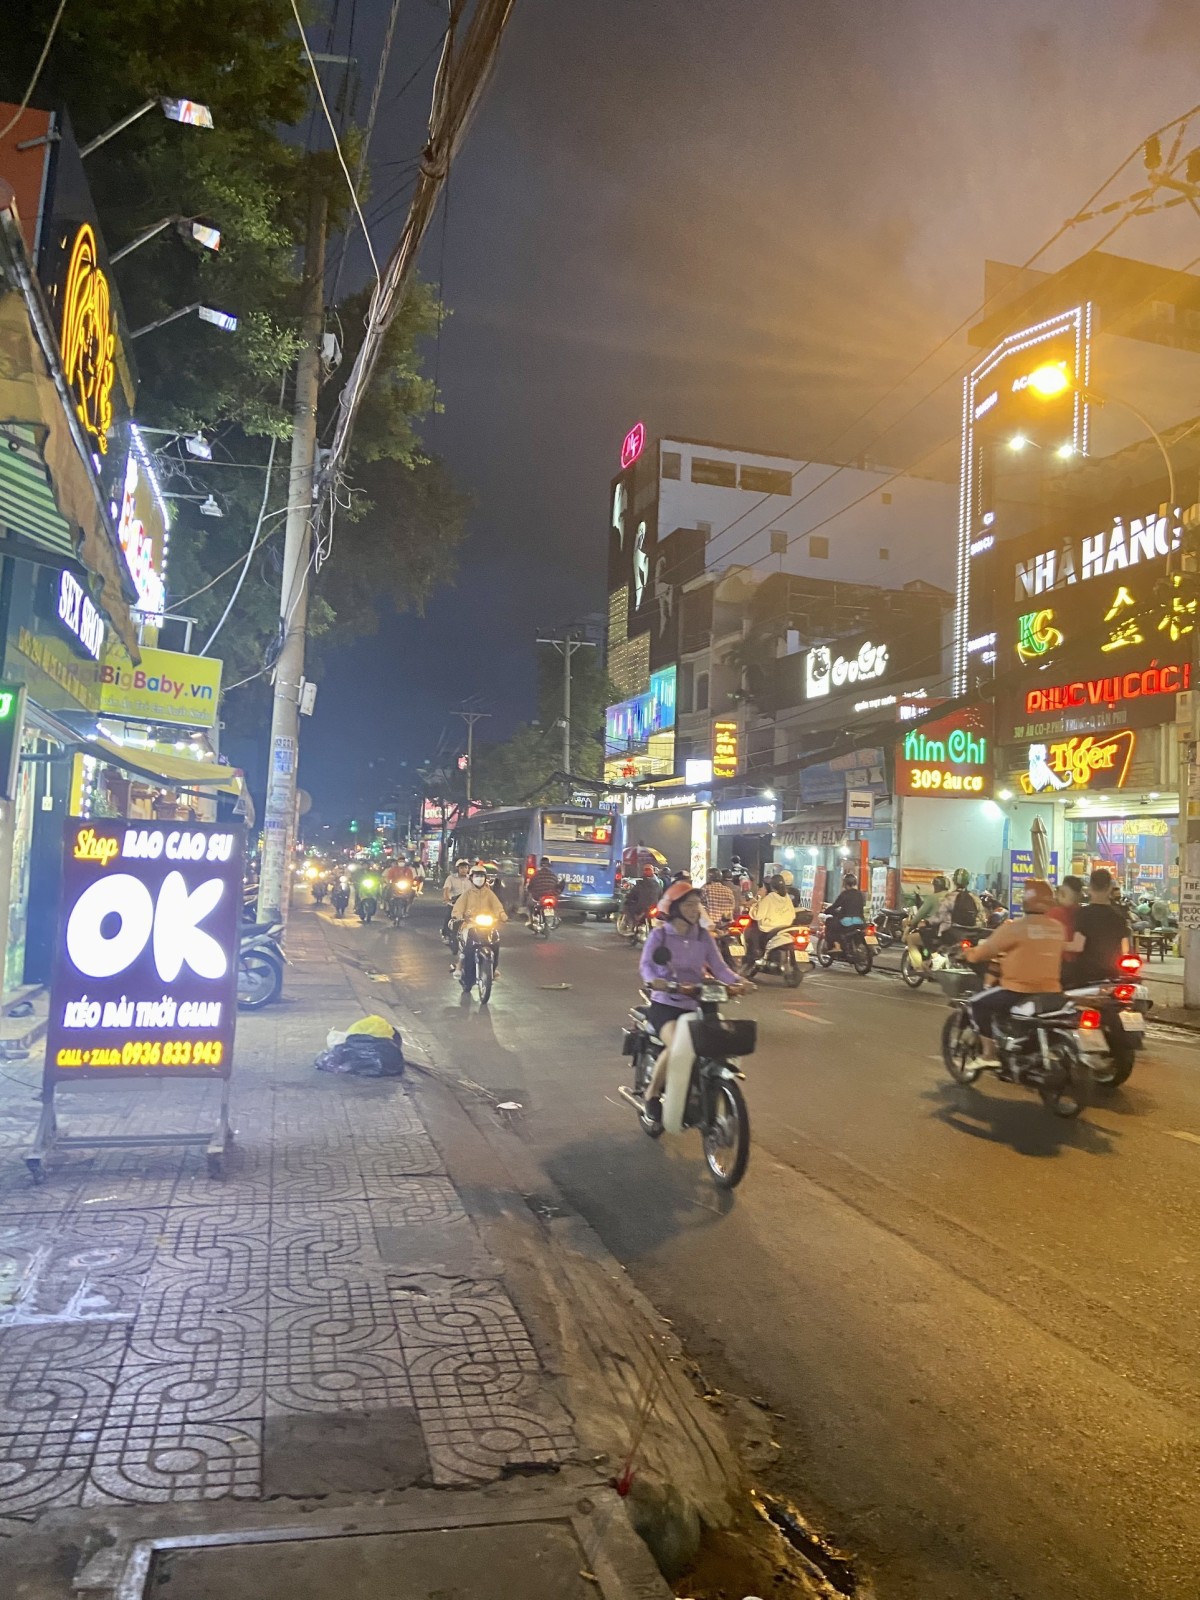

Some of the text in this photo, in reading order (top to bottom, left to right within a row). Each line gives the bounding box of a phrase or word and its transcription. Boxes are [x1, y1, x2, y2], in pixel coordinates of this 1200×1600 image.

[1014, 536, 1077, 602] NHÀ
[58, 570, 105, 661] SEX SHOP
[101, 665, 213, 699] BigBaby.vn
[1087, 676, 1122, 709] VỤ
[1123, 659, 1180, 699] CÁC
[948, 729, 987, 764] Chi
[1049, 736, 1119, 783] Tiger
[910, 769, 942, 788] 309
[942, 771, 962, 790] âu
[74, 828, 233, 866] Shop BAO CAO SU
[66, 870, 227, 983] OK
[63, 994, 221, 1028] KÉO DÀI THỜI GIAN
[121, 1041, 161, 1066] 0936
[161, 1041, 192, 1065] 833
[192, 1041, 223, 1065] 943
